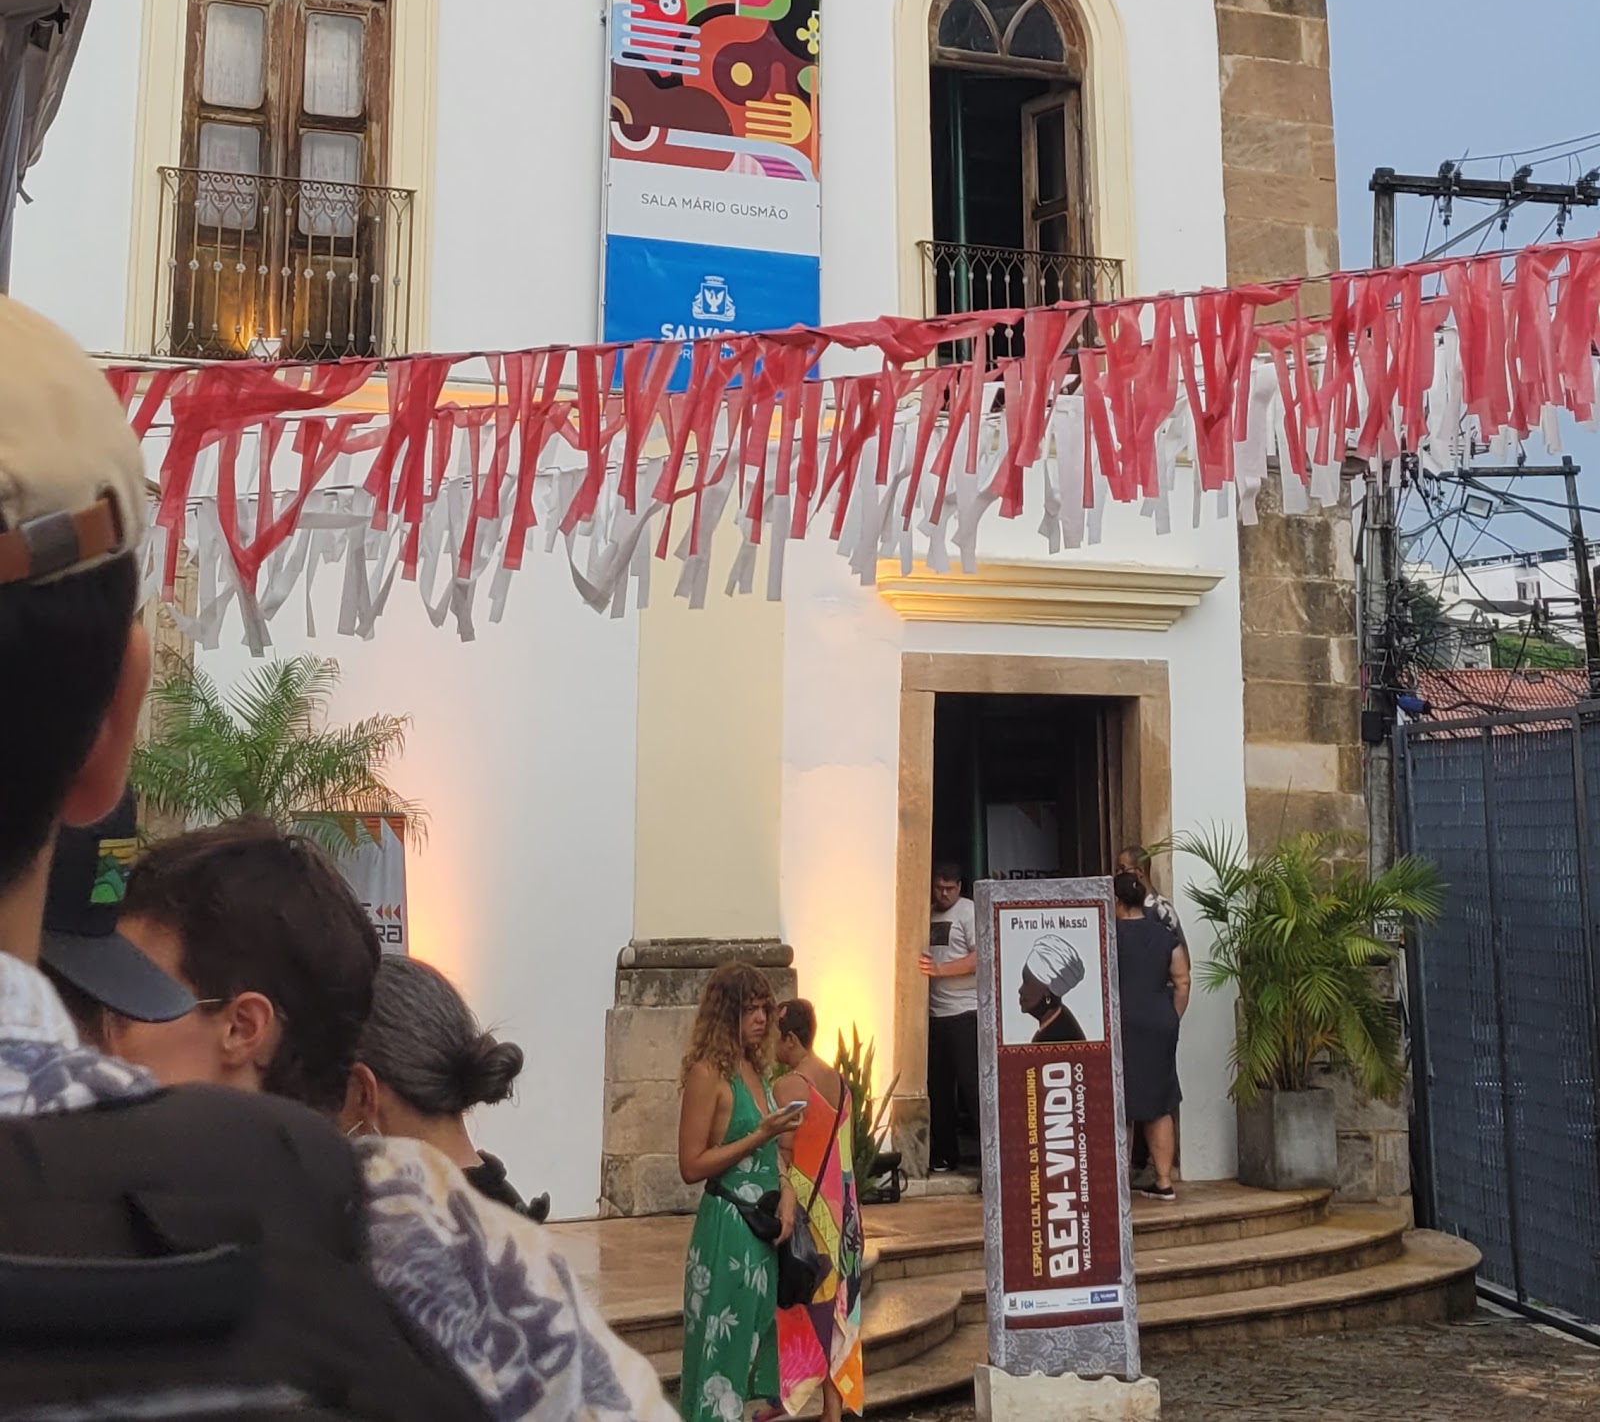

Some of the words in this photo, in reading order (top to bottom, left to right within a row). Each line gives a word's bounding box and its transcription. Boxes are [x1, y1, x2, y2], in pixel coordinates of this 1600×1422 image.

[641, 193, 677, 209] SALA
[682, 197, 726, 213] MÁRIO
[730, 204, 788, 220] GUSMÃO
[1026, 1067, 1038, 1144] BARROQUINHA
[1029, 1148, 1039, 1163] DA
[1042, 1062, 1079, 1278] BEM-VINDO
[1078, 1133, 1090, 1203] BIENVENIDO
[1030, 1165, 1041, 1227] CULTURAL
[1032, 1230, 1043, 1277] ESPAÇO
[1081, 1211, 1091, 1271] WELCOME
